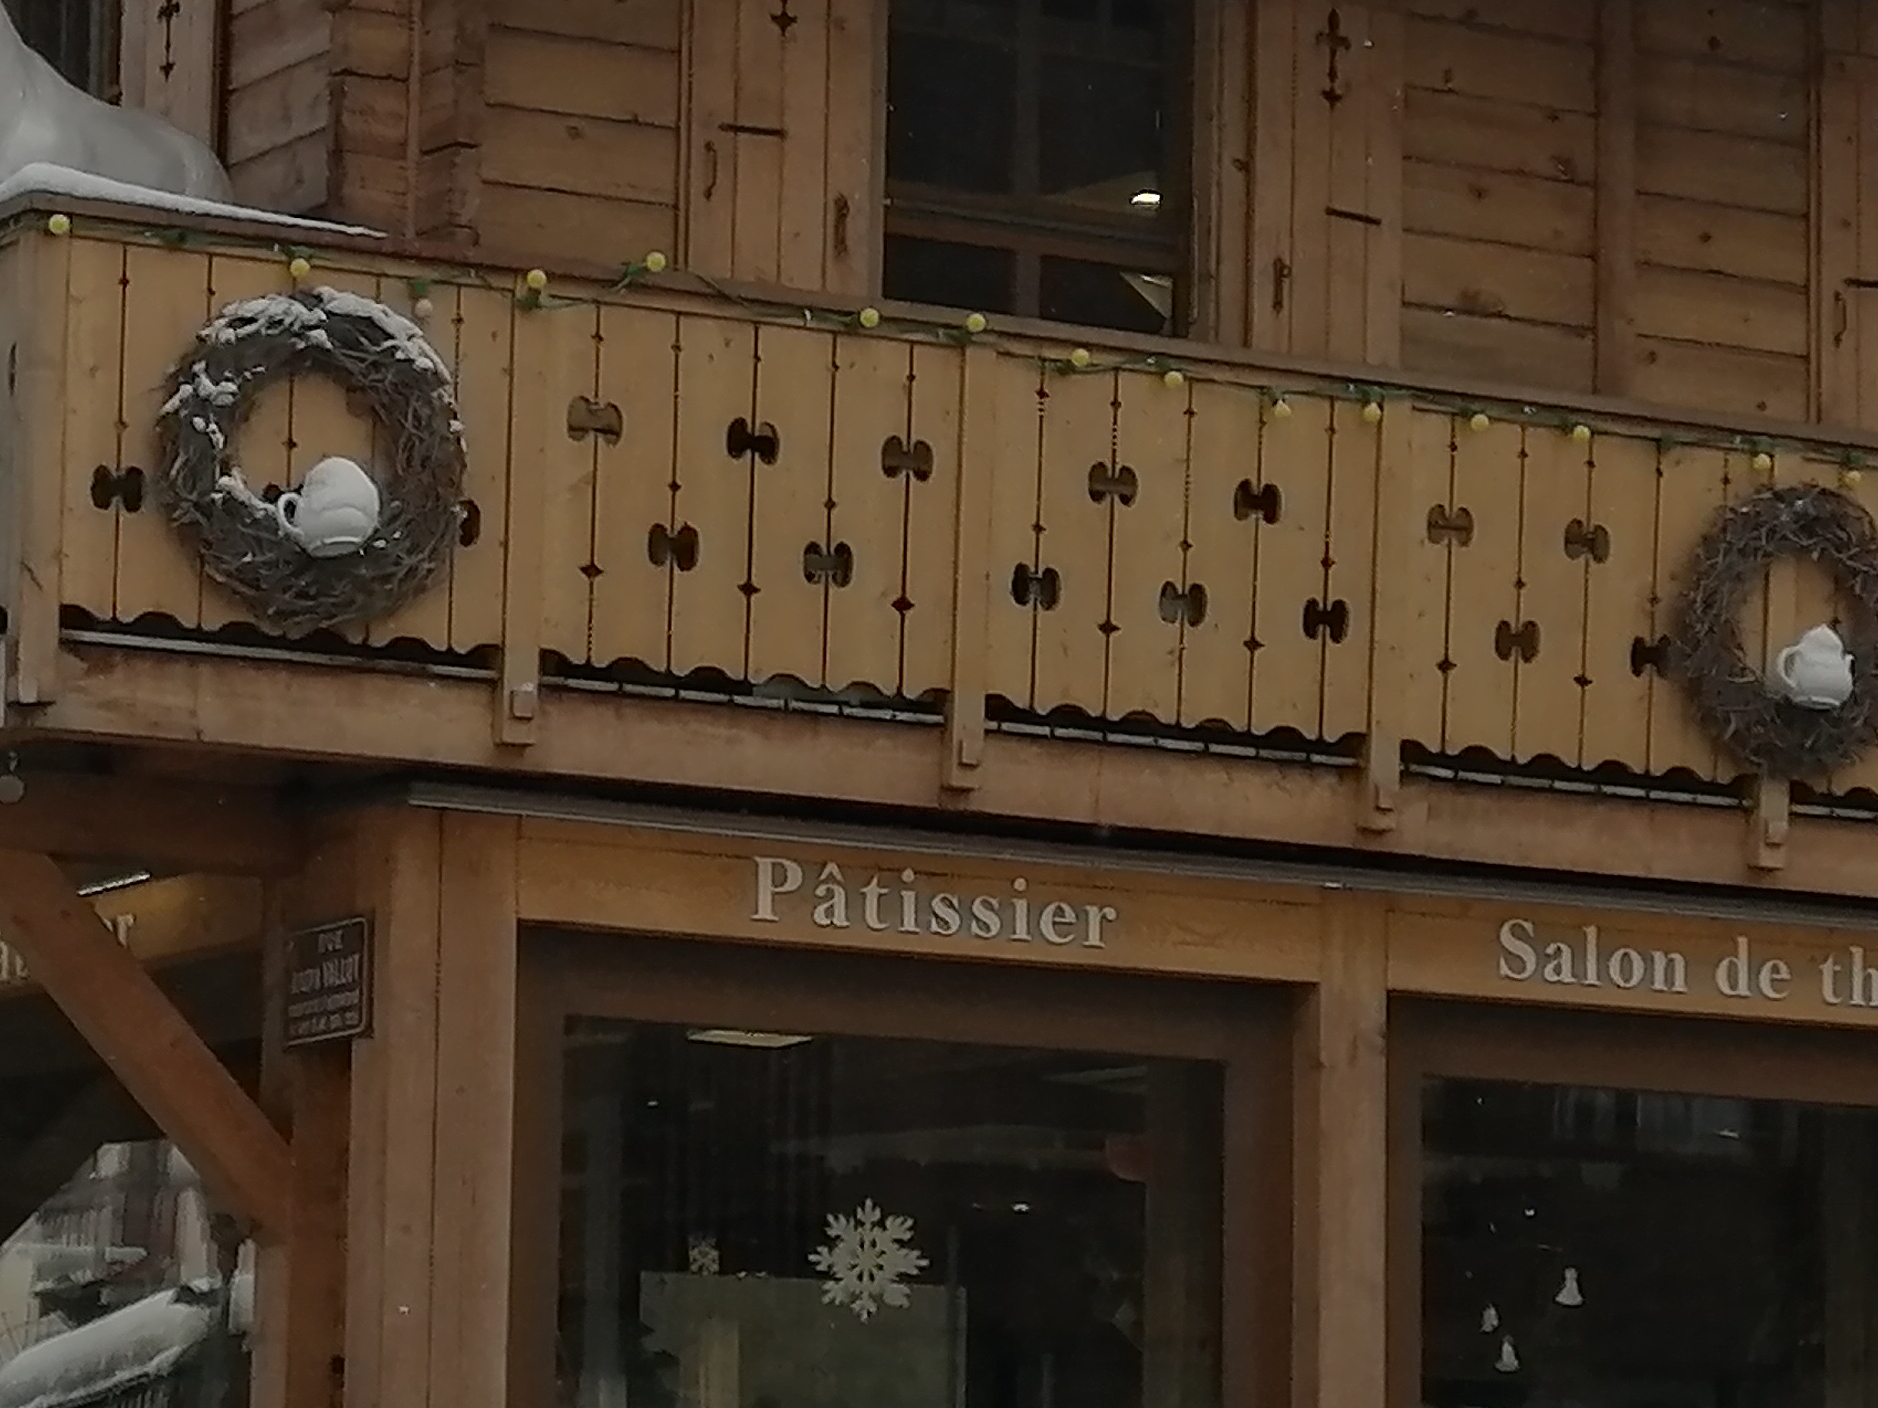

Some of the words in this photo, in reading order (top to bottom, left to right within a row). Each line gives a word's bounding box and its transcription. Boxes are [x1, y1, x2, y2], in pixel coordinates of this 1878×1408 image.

[750, 856, 1120, 950] Pâtissier
[1497, 918, 1689, 994] Salon
[1715, 935, 1793, 1002] de
